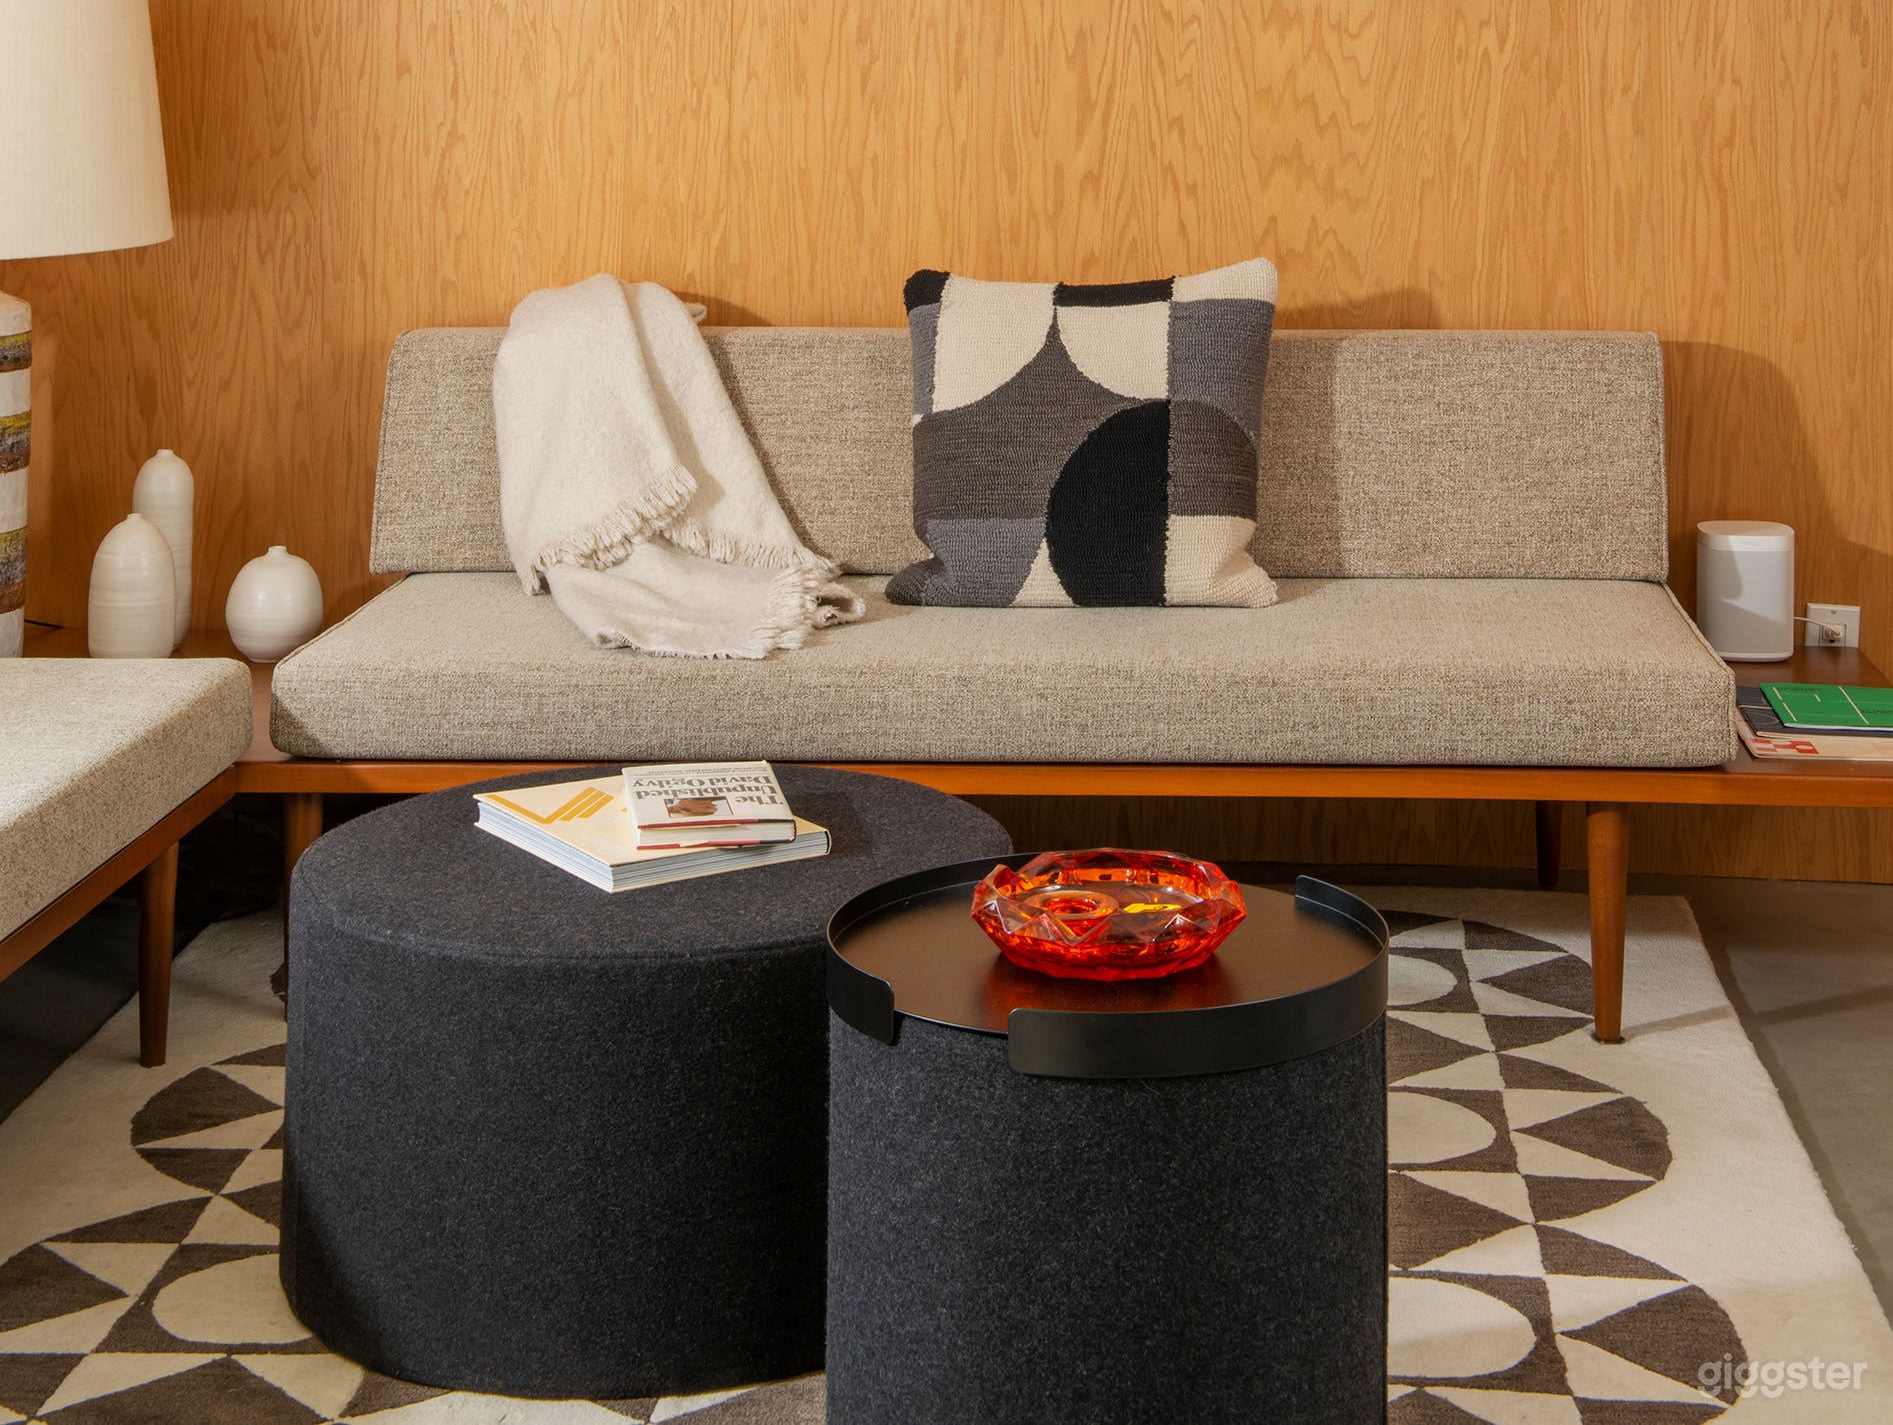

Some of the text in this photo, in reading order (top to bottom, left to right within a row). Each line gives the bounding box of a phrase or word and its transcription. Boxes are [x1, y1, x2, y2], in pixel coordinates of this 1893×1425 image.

[632, 775, 773, 788] David Ogilvy
[636, 785, 777, 800] Unpublished
[734, 794, 784, 805] The
